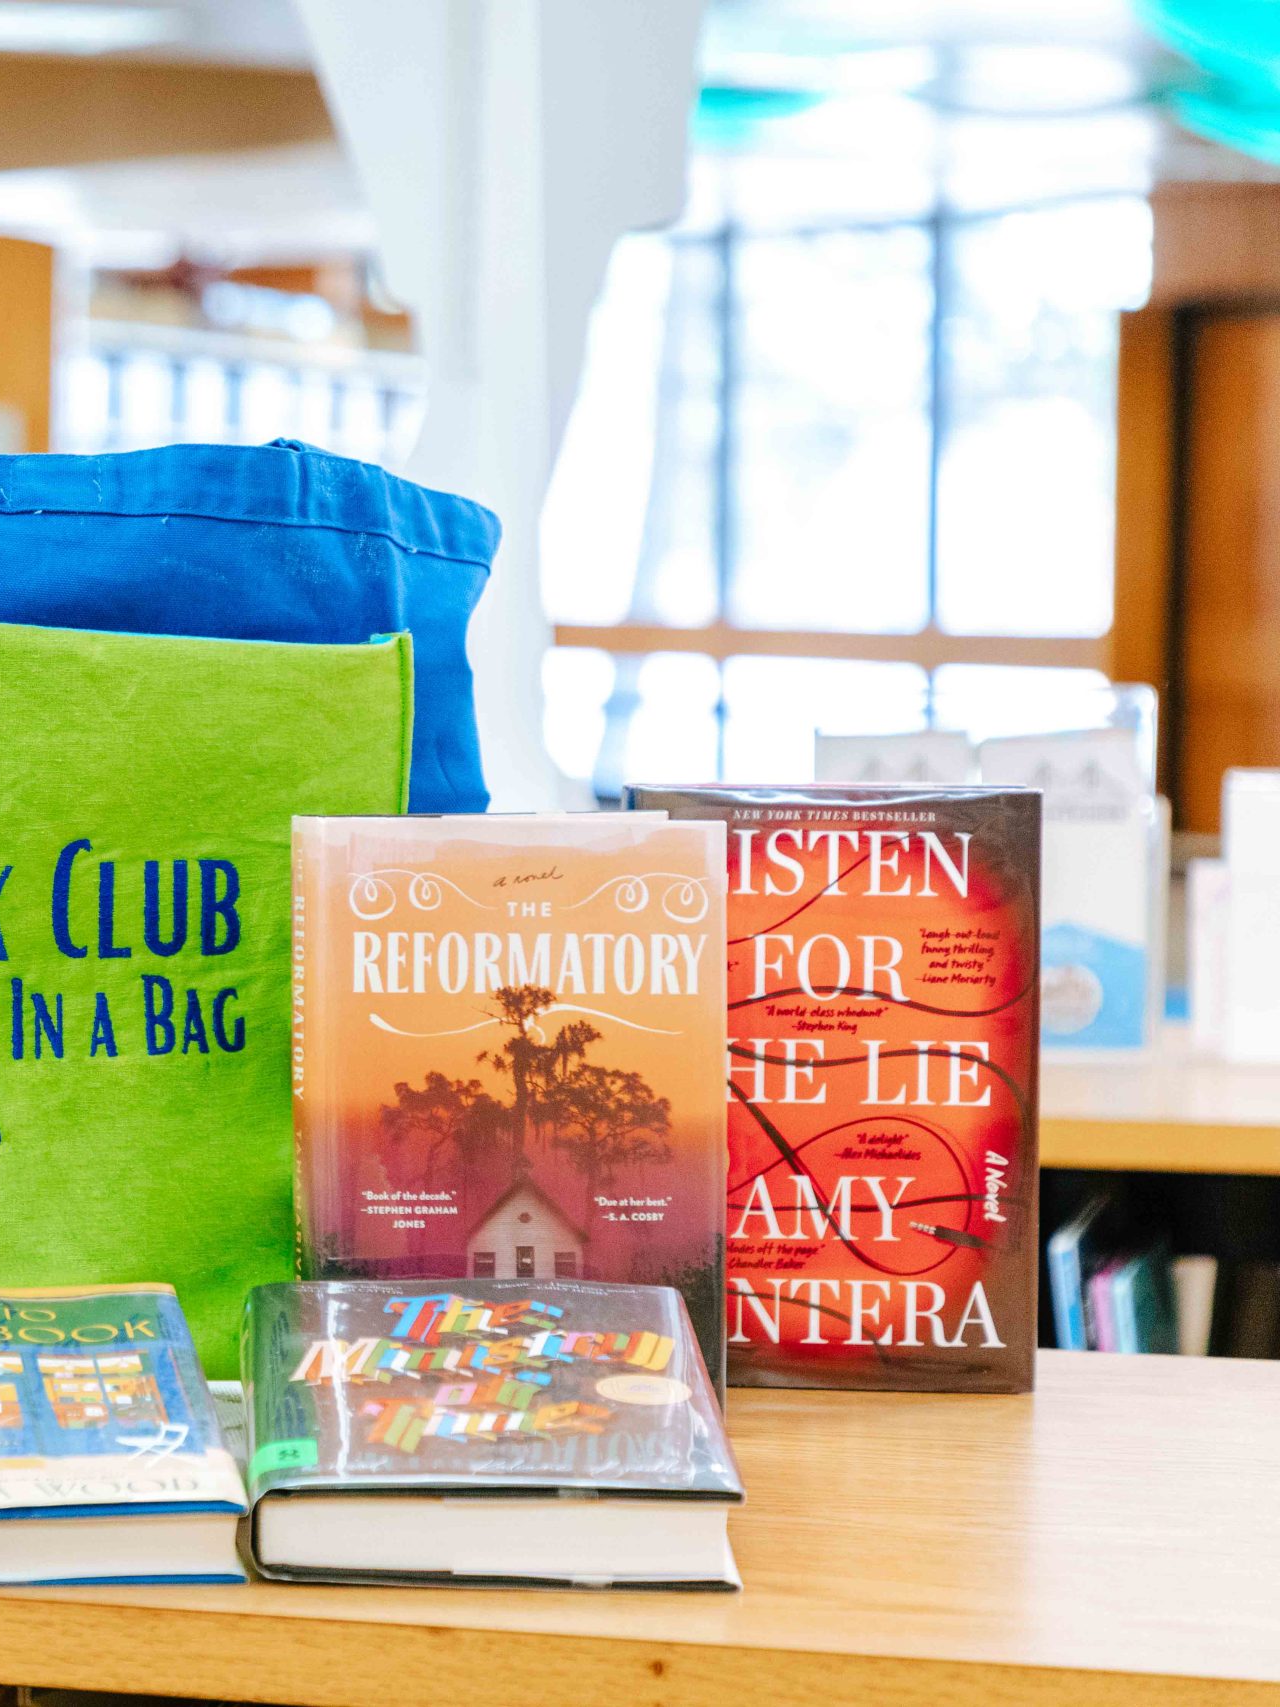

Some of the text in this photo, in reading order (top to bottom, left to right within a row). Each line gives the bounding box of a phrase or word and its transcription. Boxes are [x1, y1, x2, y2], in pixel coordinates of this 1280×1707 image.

[733, 809, 936, 822] NEW YORK TIMES BESTSELLER
[493, 878, 508, 888] a
[726, 829, 973, 898] ISTEN
[51, 838, 242, 959] CLUB
[507, 901, 553, 917] THE
[353, 932, 709, 995] REFORMATORY
[747, 934, 910, 1002] FOR
[929, 959, 949, 969] and
[11, 974, 246, 1059] IN A BAG
[295, 896, 304, 1100] REFORMATORY
[860, 1040, 990, 1106] LIE
[391, 1191, 402, 1200] of
[402, 1191, 417, 1200] the
[619, 1198, 628, 1206] at
[629, 1196, 645, 1206] her
[984, 1150, 1009, 1223] A Novel
[393, 1220, 426, 1228] JONES
[414, 1206, 458, 1214] GRAHAM
[631, 1212, 664, 1221] COSBY
[730, 1174, 916, 1241] AMY
[2, 1305, 57, 1323] TO
[728, 1277, 1007, 1348] NTERA
